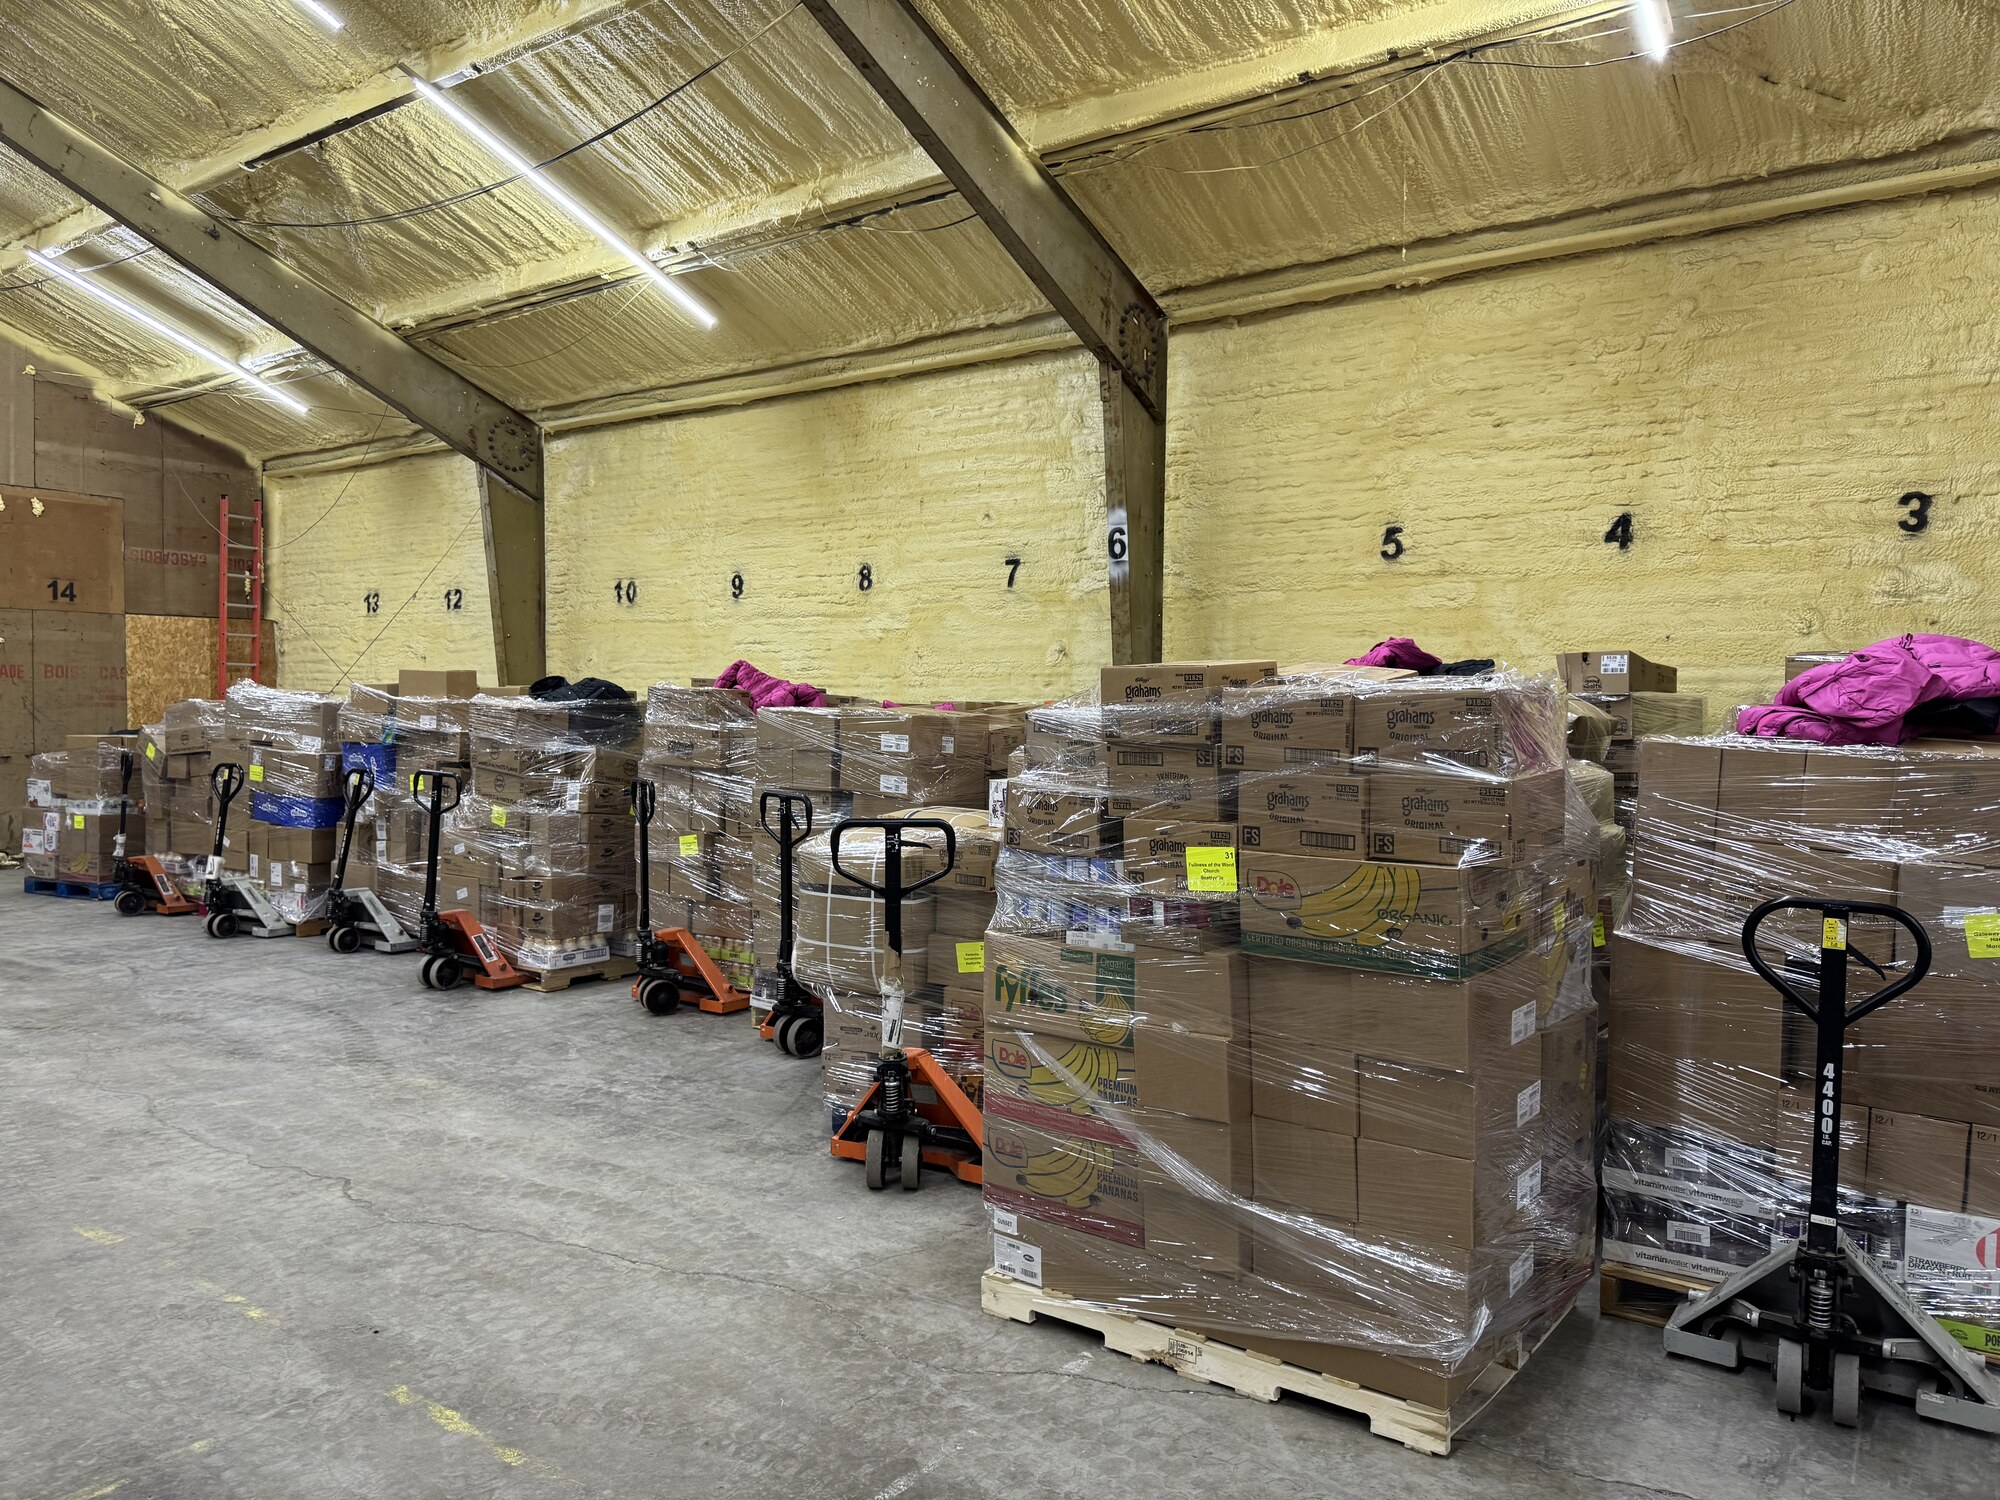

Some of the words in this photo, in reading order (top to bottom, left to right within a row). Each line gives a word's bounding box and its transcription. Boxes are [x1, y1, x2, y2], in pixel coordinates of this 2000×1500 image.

[1899, 491, 1933, 533] 3
[1604, 513, 1634, 551] 4
[1107, 526, 1127, 560] 6
[1380, 526, 1404, 560] 5
[858, 563, 874, 592] 8
[1004, 557, 1021, 588] 7
[47, 579, 77, 602] 14
[614, 580, 637, 604] 10
[730, 573, 744, 599] 9
[363, 592, 380, 613] 13
[444, 589, 462, 610] 12
[1184, 674, 1204, 682] 91829
[1125, 684, 1161, 699] grahams
[1251, 708, 1294, 729] grahams
[1386, 709, 1435, 730] grahams
[1253, 731, 1290, 741] ORIGINAL
[1389, 732, 1431, 742] ORIGINAL
[1227, 747, 1244, 764] FS
[1336, 785, 1359, 793] 91829
[1267, 791, 1310, 811] grahams
[1401, 795, 1450, 817] grahams
[1269, 812, 1306, 824] ORIGINAL
[1404, 818, 1446, 830] ORIGINAL
[1007, 829, 1020, 845] FS
[1244, 827, 1260, 845] FS
[1375, 835, 1394, 853] FS
[1149, 838, 1187, 857] grahams
[1224, 852, 1234, 860] 31
[1256, 876, 1295, 894] Dole
[1377, 908, 1453, 926] ORGANIC
[1246, 932, 1284, 946] CERTIFIED
[1285, 936, 1321, 951] ORGANIC
[1100, 956, 1132, 971] Organic
[999, 1047, 1027, 1066] Dole
[1097, 1076, 1138, 1096] PREMIUM
[1781, 1100, 1800, 1110] 12/1
[1821, 1062, 1836, 1135] 4400
[1875, 1115, 1894, 1126] 12/1
[1976, 1131, 1997, 1143] 12/1
[1097, 1170, 1138, 1189] PREMIUM
[1096, 1182, 1138, 1202] BANANAS
[1633, 1178, 1687, 1194] vitaminwater
[1688, 1188, 1745, 1206] vitaminwater
[1635, 1251, 1689, 1268] vitaminwater
[1908, 1255, 1969, 1272] STRAWBERRY
[1908, 1261, 1946, 1274] DRAGON
